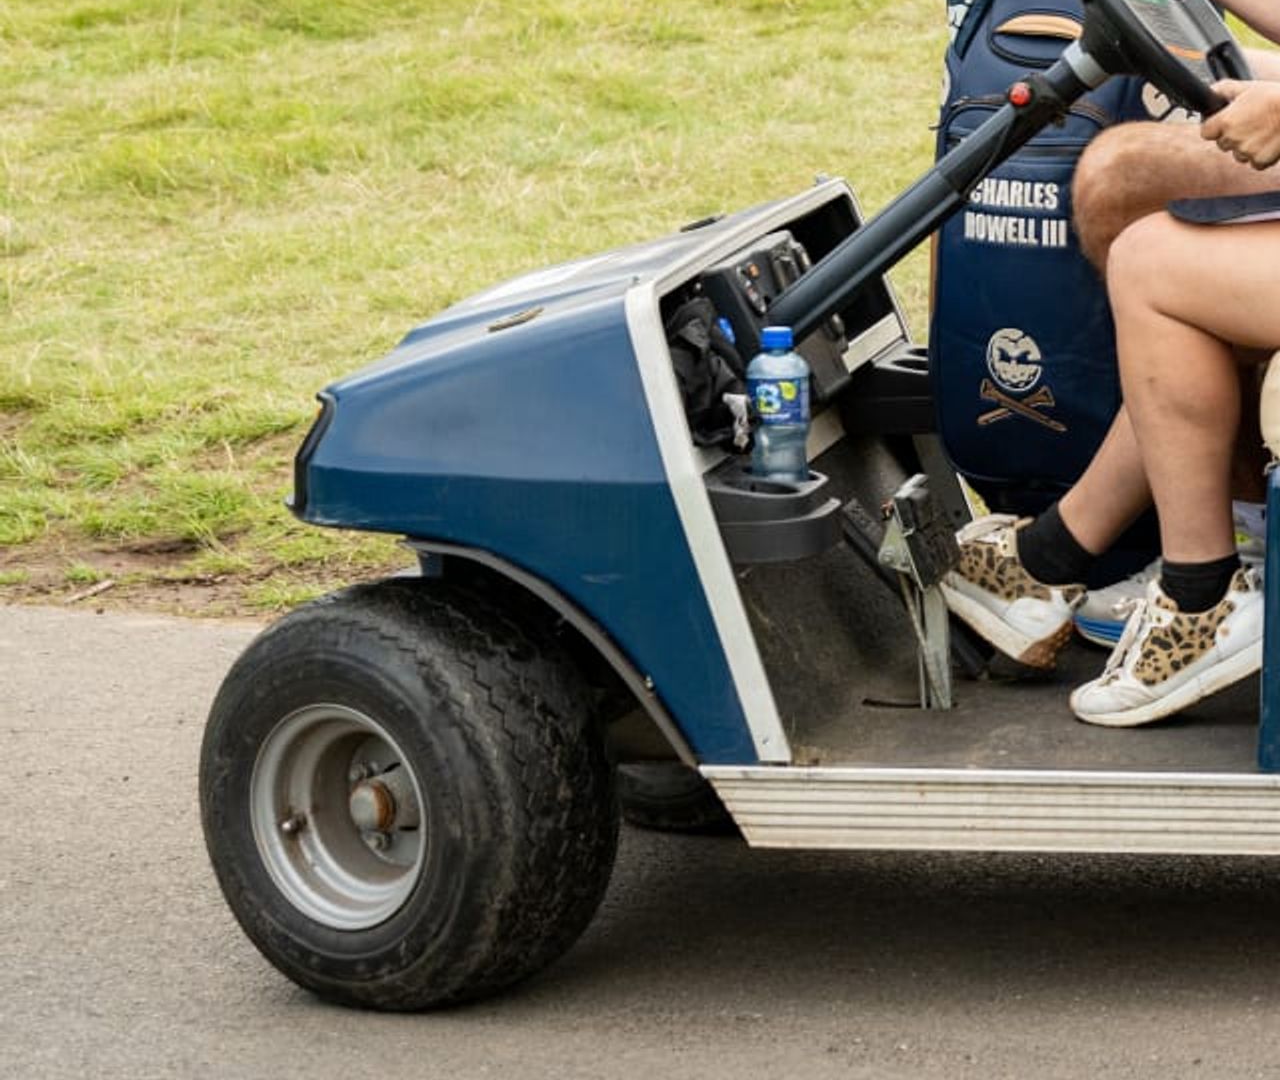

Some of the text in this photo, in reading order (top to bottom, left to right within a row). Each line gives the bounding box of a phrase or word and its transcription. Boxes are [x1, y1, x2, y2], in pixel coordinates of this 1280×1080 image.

[969, 178, 1060, 210] CHARLES
[964, 211, 1068, 248] HOWELL III
